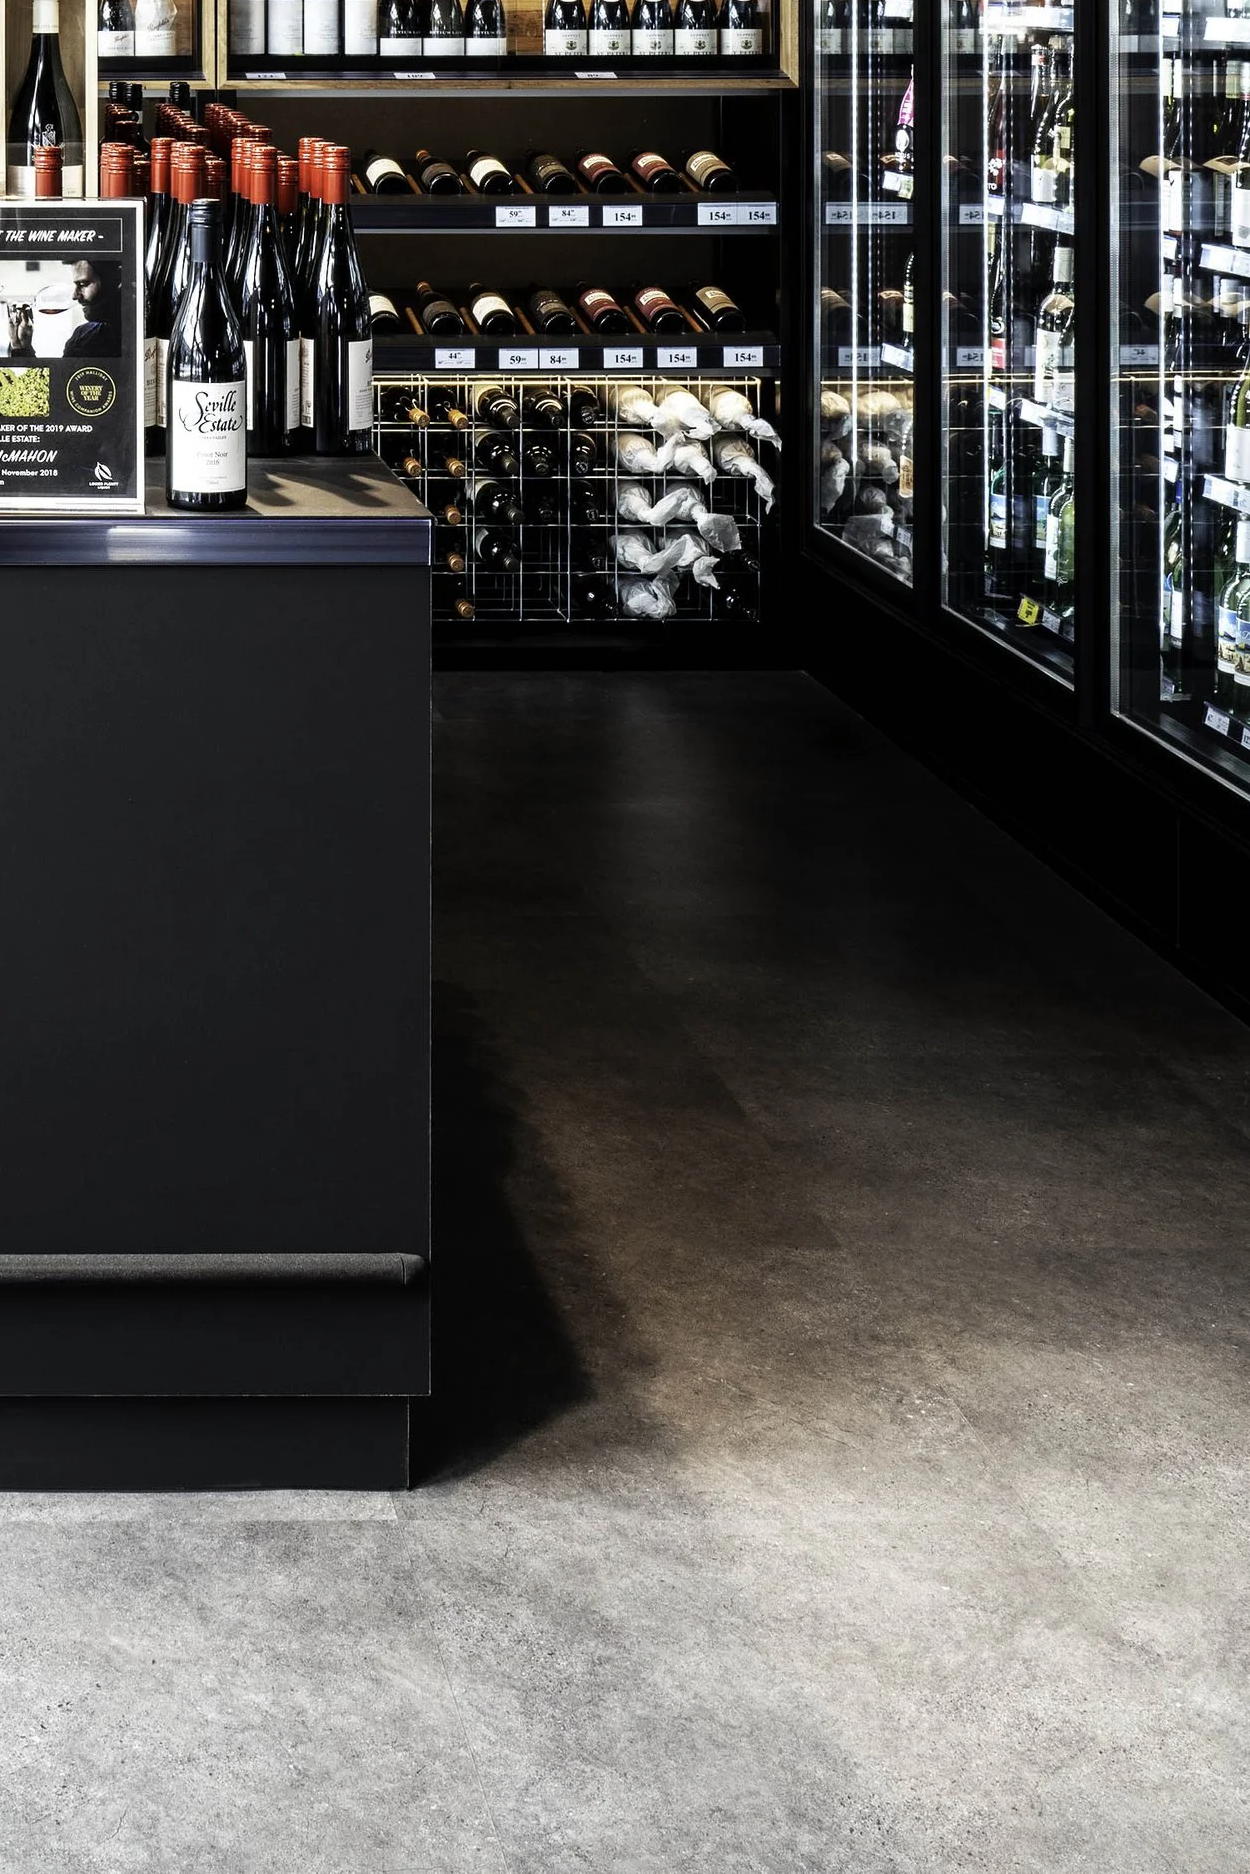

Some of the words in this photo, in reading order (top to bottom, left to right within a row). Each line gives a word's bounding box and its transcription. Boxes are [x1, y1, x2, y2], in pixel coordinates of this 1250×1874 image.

[5, 229, 27, 243] THE
[28, 229, 57, 243] WINE
[57, 229, 96, 243] MAKER
[195, 390, 237, 426] Seville
[16, 424, 28, 432] OF
[29, 424, 44, 432] THE
[45, 424, 63, 432] 2019
[64, 425, 93, 433] AWARD
[198, 413, 244, 434] Estate
[11, 435, 40, 443] ESTATE:
[1, 468, 39, 477] November
[39, 469, 58, 477] 2018
